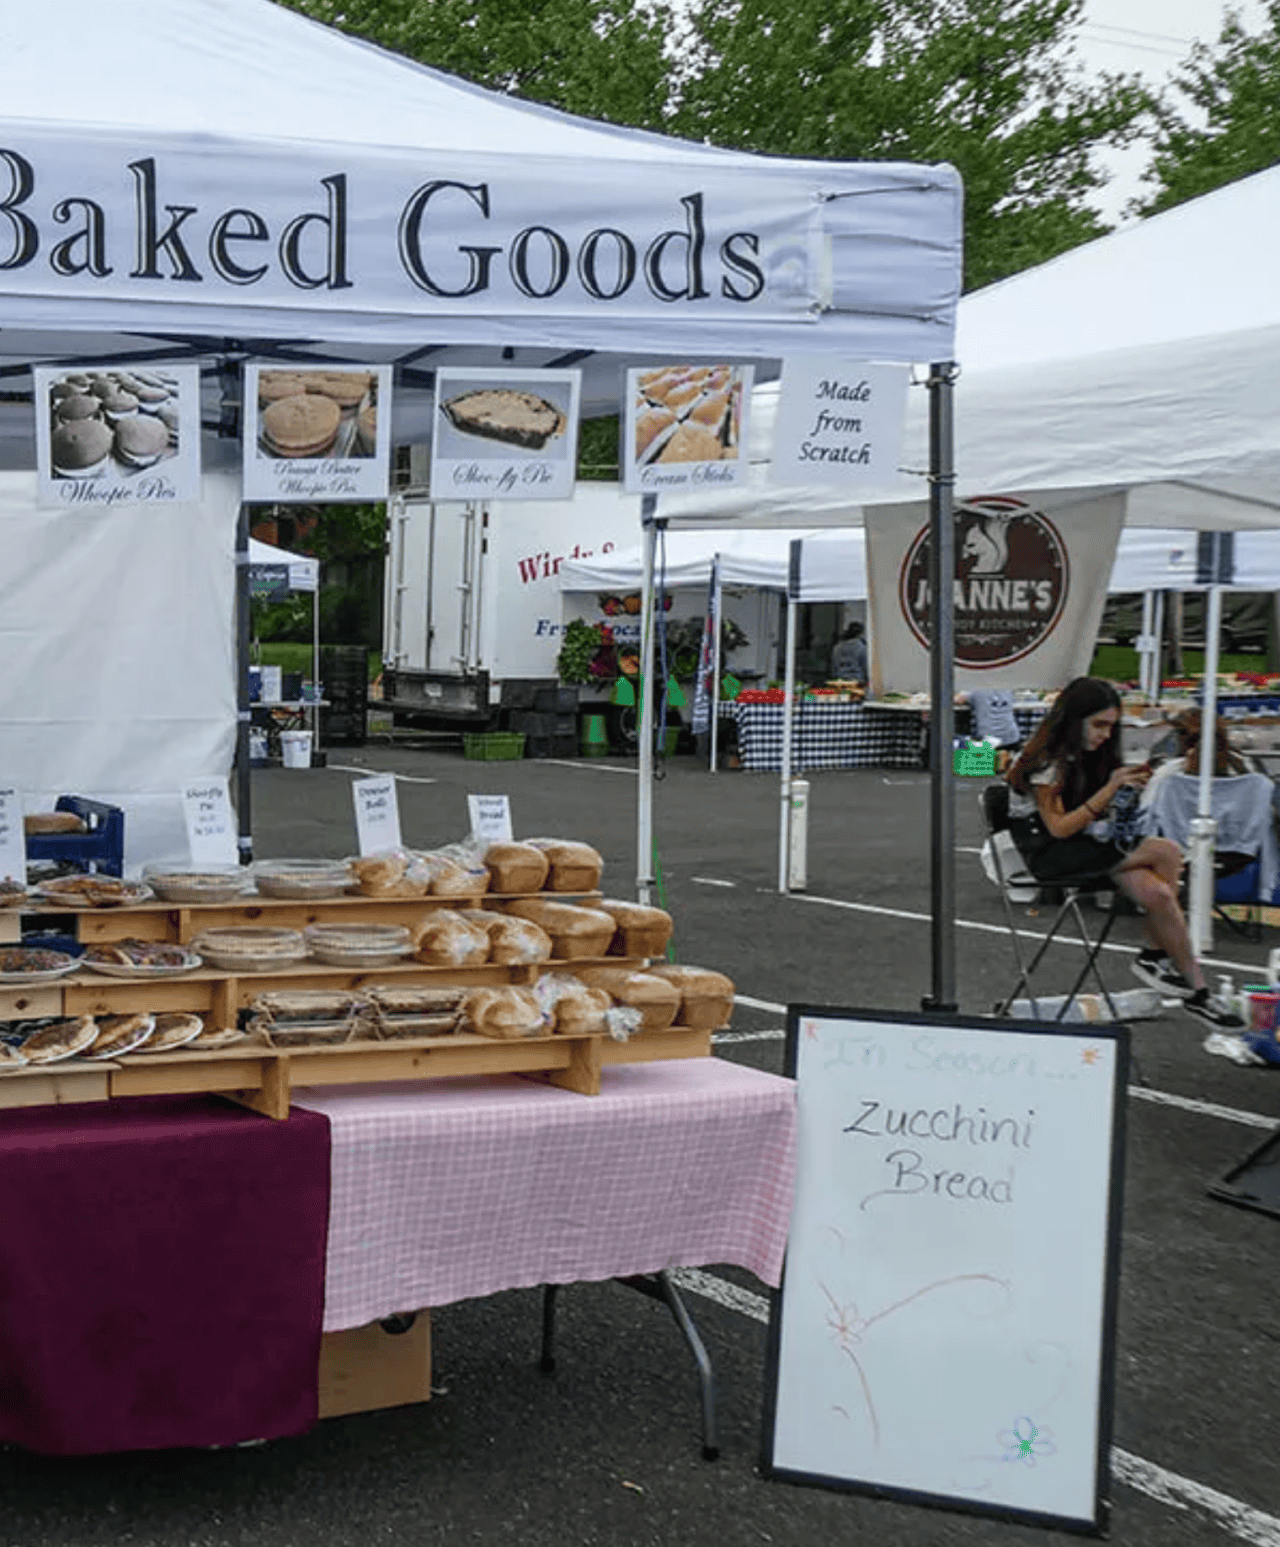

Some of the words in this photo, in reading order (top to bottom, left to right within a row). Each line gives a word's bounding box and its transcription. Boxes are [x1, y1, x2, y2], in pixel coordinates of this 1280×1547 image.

[398, 180, 765, 302] Goods
[816, 380, 870, 402] Made
[811, 411, 861, 436] from
[799, 441, 871, 465] Scratch
[274, 460, 318, 475] Peanut
[320, 459, 361, 474] Butter
[522, 463, 554, 484] Pie
[640, 467, 688, 486] Cream
[690, 463, 734, 484] Sticks
[60, 479, 132, 503] Whoopie
[137, 477, 176, 499] Pies
[914, 579, 1052, 612] JANNE'S
[822, 1037, 886, 1070] In
[843, 1100, 1037, 1148] Zucchini
[861, 1149, 1015, 1208] Bread
